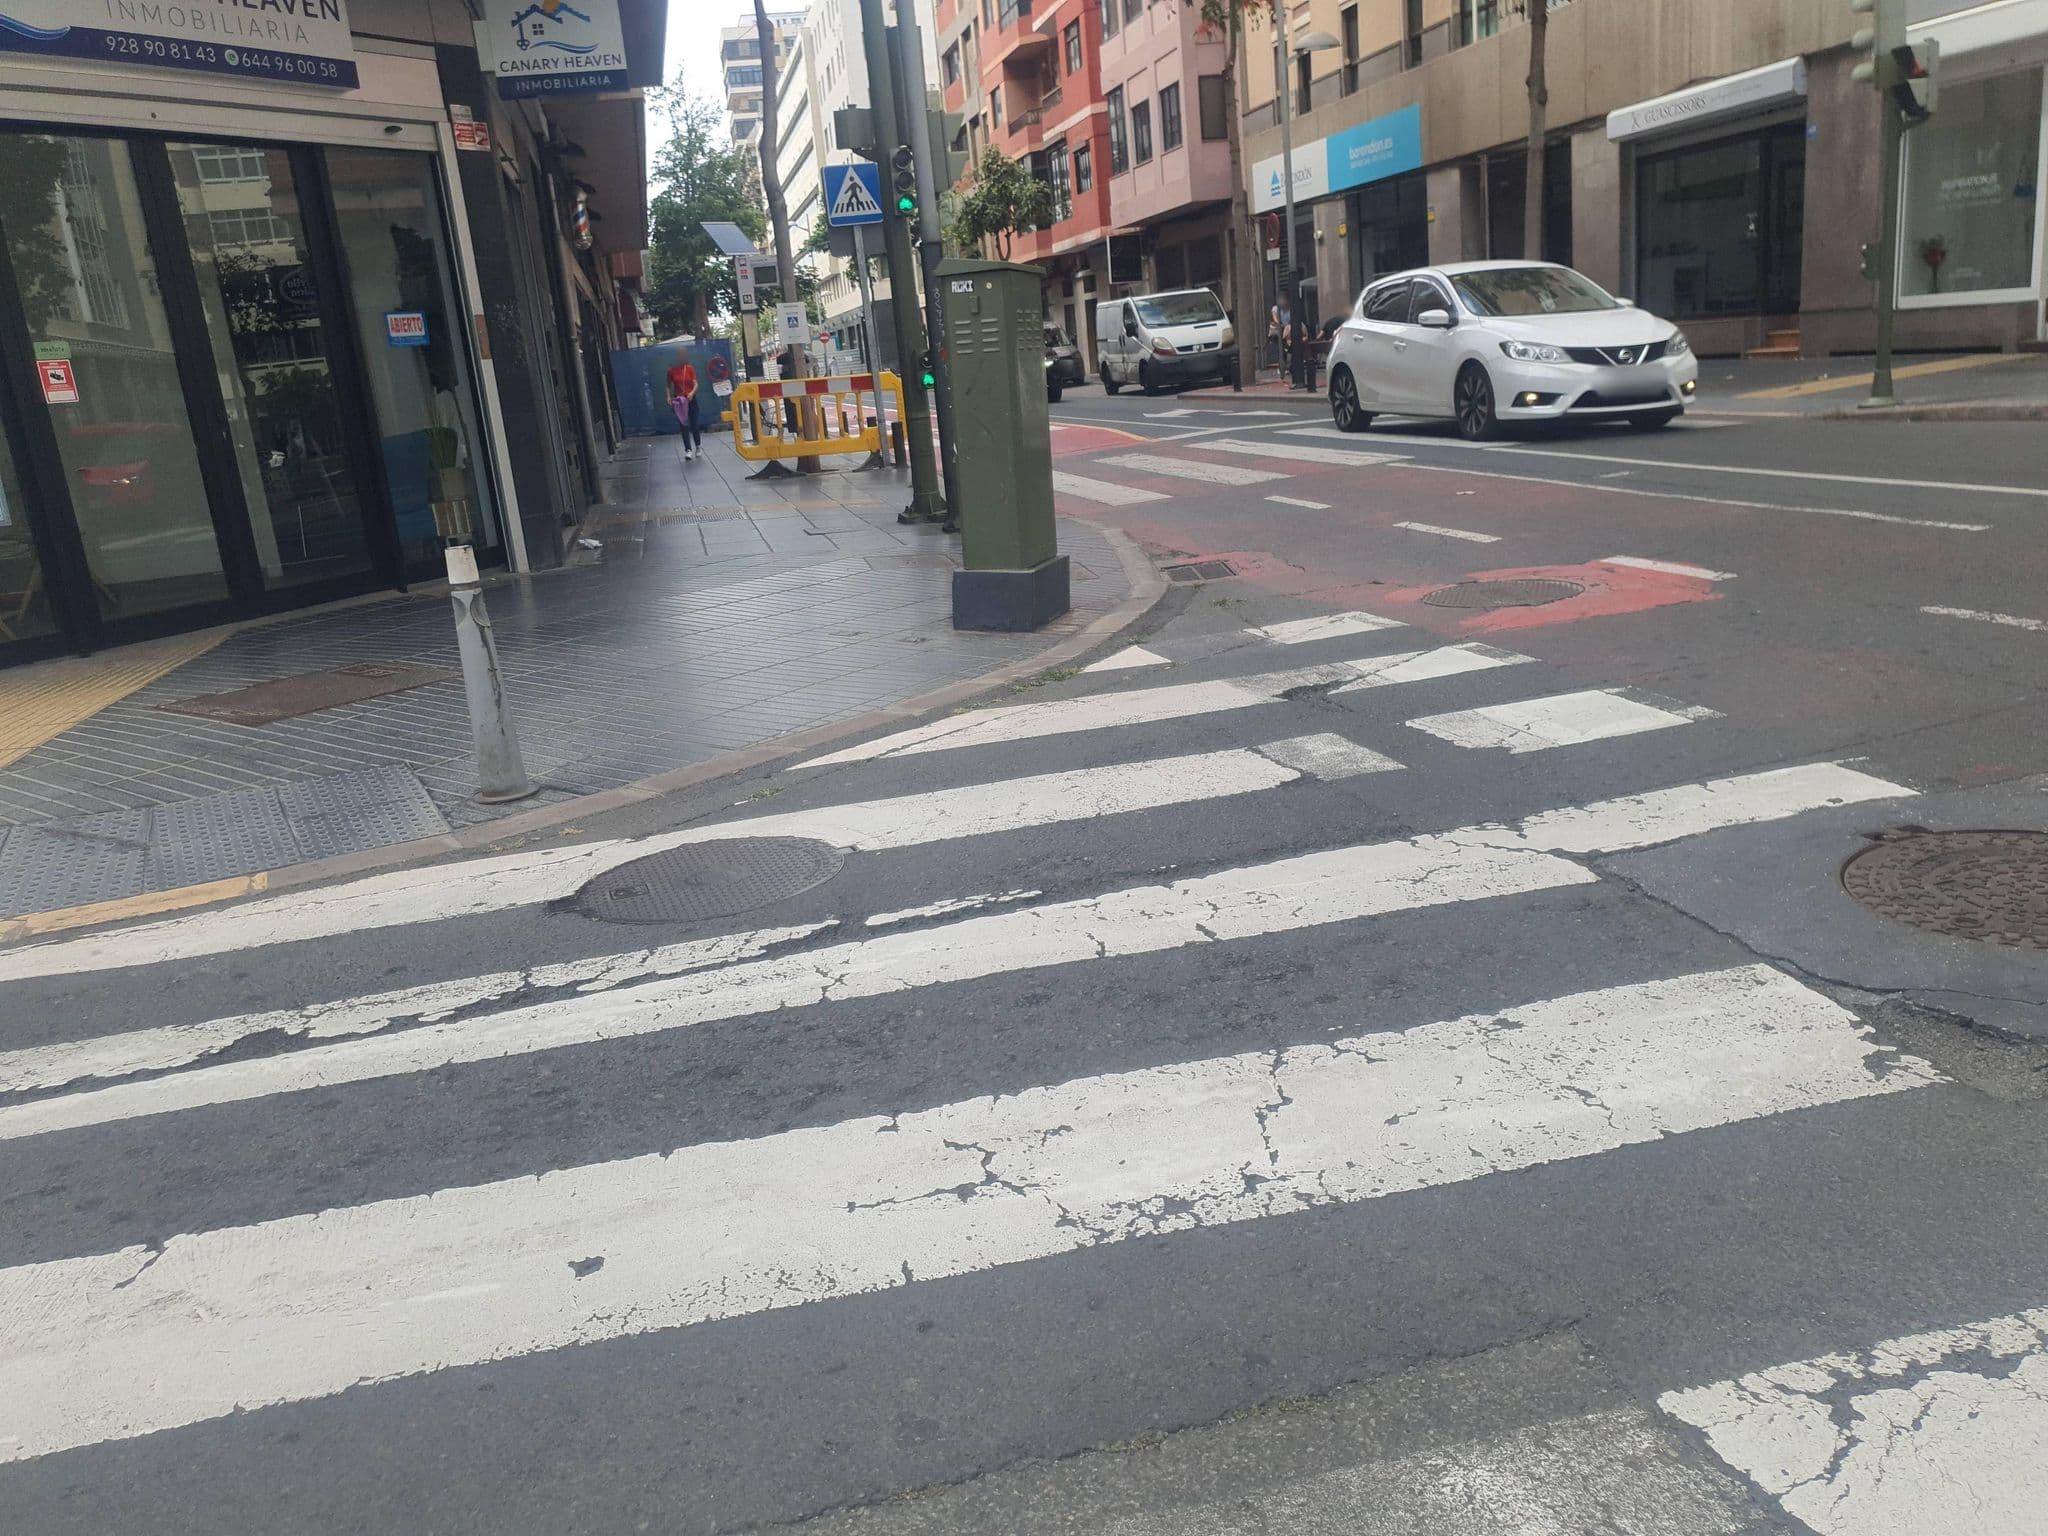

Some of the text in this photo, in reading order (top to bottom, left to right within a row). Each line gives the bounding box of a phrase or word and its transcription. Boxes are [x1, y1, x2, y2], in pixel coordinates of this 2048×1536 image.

[107, 1, 309, 44] INMOBILIARIA
[106, 36, 338, 78] 928 90 81 43 644 96 00 58
[500, 54, 622, 72] CANARY HEAVEN
[517, 75, 612, 91] INMOBILIARIA
[390, 316, 423, 333] ABIERTO
